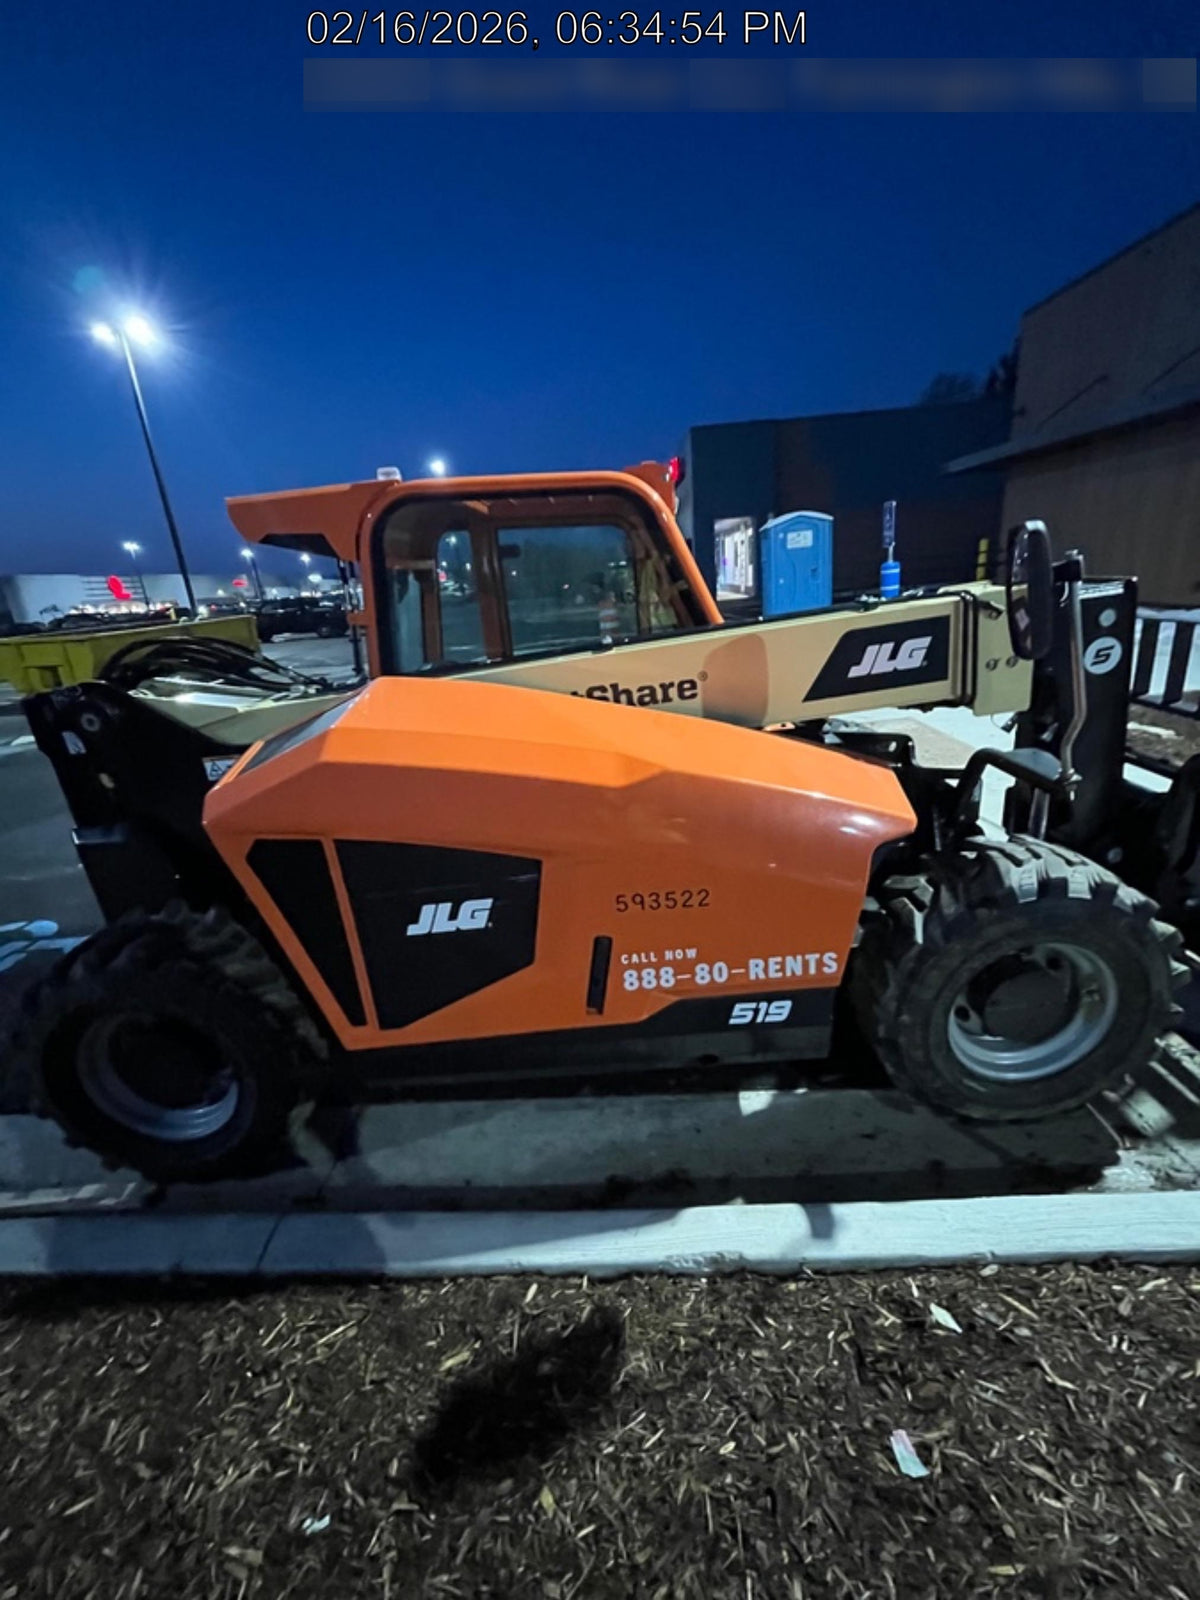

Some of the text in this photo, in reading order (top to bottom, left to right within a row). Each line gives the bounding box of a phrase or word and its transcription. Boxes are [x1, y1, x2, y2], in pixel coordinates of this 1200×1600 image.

[847, 636, 932, 678] JLG
[615, 888, 710, 912] 593522
[406, 897, 494, 936] JLG
[620, 948, 698, 965] CALL NOW
[623, 952, 839, 991] 888-80-RENTS
[728, 1000, 793, 1025] 519
